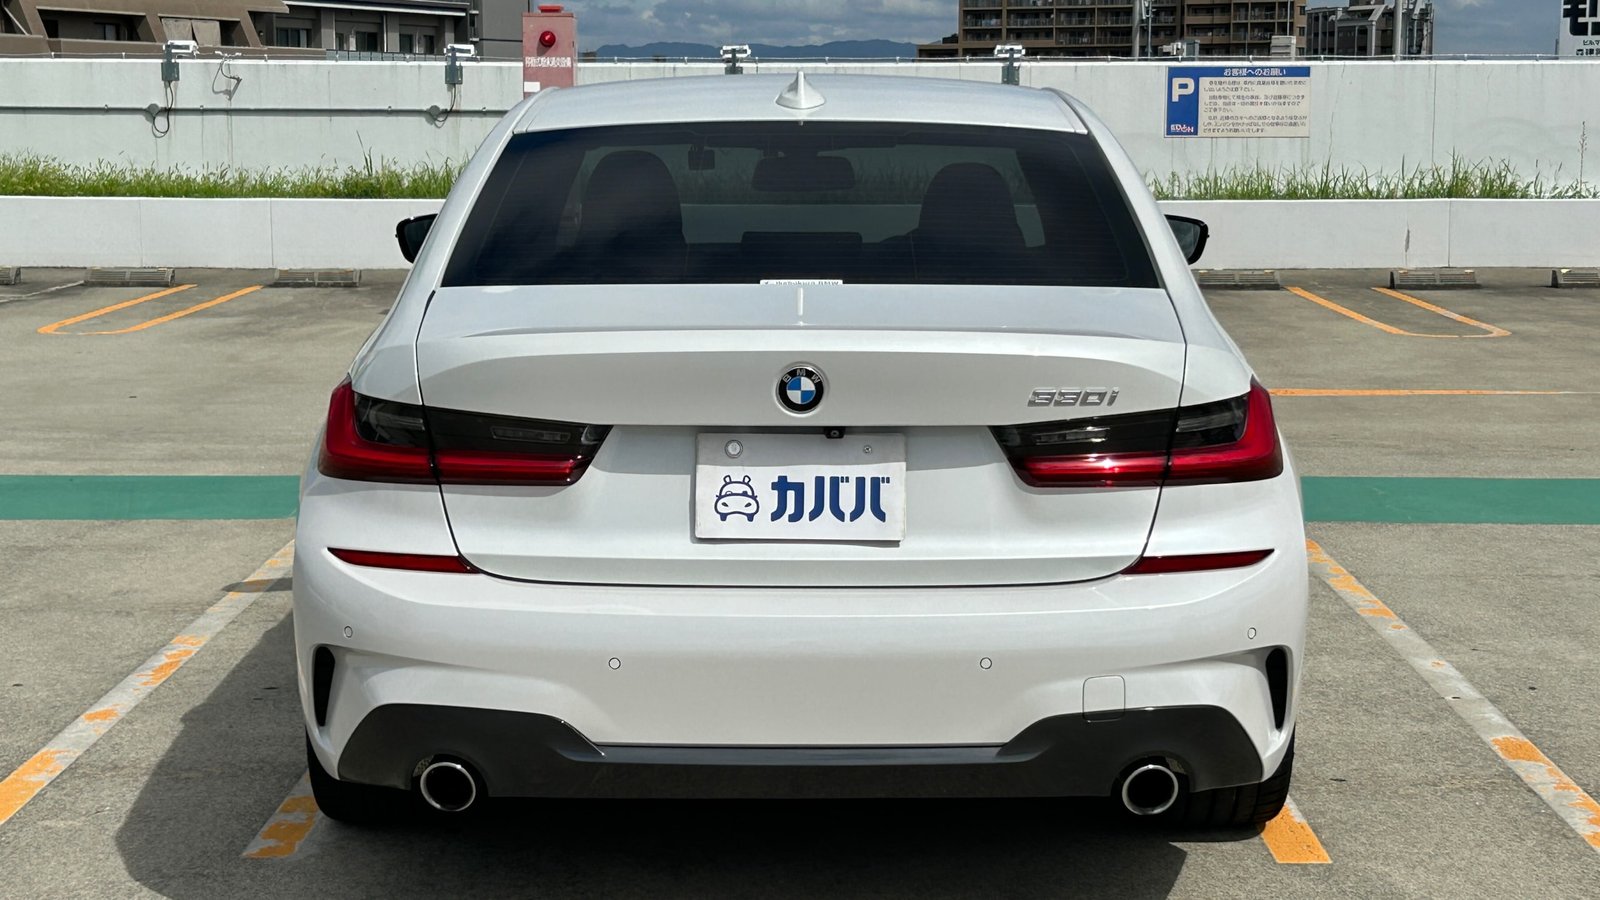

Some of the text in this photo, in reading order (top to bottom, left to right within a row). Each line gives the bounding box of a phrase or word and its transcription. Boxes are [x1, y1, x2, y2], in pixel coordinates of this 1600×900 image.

[1223, 68, 1287, 76] お客様へのお願い
[1172, 78, 1195, 102] P
[783, 368, 821, 383] BMW
[1027, 386, 1120, 407] 330i
[771, 475, 890, 522] カババ
